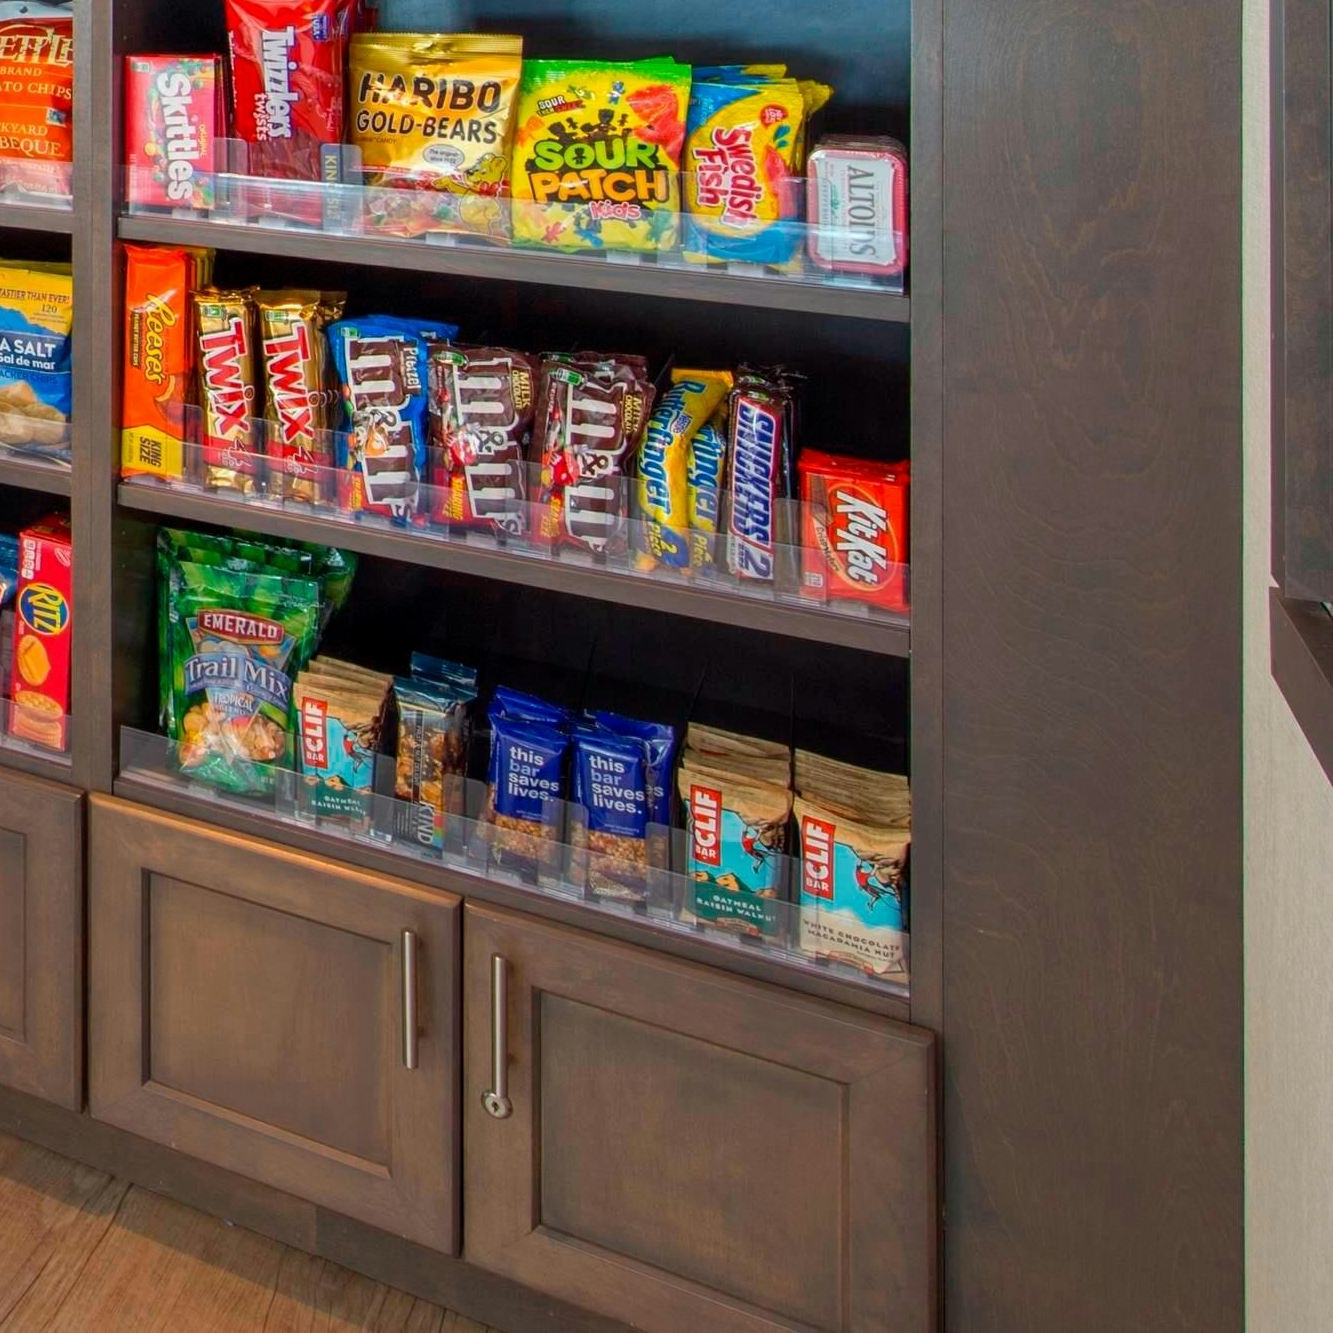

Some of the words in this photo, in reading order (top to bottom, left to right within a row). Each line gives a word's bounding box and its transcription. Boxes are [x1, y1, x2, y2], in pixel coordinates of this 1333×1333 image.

[0, 66, 43, 78] BRAND
[262, 25, 299, 139] Twizzlers
[27, 81, 73, 100] CHIPS
[358, 72, 502, 113] HARIBO
[538, 95, 566, 110] SOUR
[254, 92, 269, 142] twists
[357, 110, 497, 144] GOLD-BEARS
[157, 72, 200, 201] Skittles
[534, 136, 656, 171] SOUR
[530, 168, 669, 204] PATCH
[695, 148, 729, 206] Fish
[713, 127, 763, 228] Swedish
[589, 199, 641, 220] Kids
[847, 165, 878, 257] ALTOIDS
[26, 291, 48, 302] THAN
[48, 294, 71, 305] EVER!
[41, 303, 58, 314] 120
[10, 337, 57, 359] SALT
[145, 294, 177, 385] Reese's
[16, 354, 30, 368] de
[32, 359, 56, 371] mar
[403, 346, 421, 390] Pretzel
[518, 371, 532, 408] MILK
[140, 436, 151, 466] SIZE
[151, 439, 163, 468] KING
[640, 379, 708, 517] Butterfinger
[733, 401, 776, 547] SNICKERS
[745, 550, 771, 578] 2
[27, 583, 63, 635] RITZ
[204, 613, 278, 639] EMERALD
[187, 657, 237, 683] Trail
[244, 660, 289, 703] Mix
[214, 692, 253, 712] TROPICAL
[305, 700, 324, 753] CLIF
[306, 752, 325, 762] BAR
[509, 746, 545, 767] this
[509, 759, 540, 778] bar
[589, 754, 626, 774] this
[508, 772, 560, 792] saves
[590, 768, 623, 786] bar
[508, 782, 555, 803] lives.
[591, 782, 646, 802] saves
[593, 792, 643, 815] lives.
[694, 790, 718, 849] CLIF
[695, 846, 717, 860] BAR
[805, 821, 831, 880] CLIF
[805, 878, 830, 893] BAR
[696, 897, 733, 913] RAISIN
[712, 894, 762, 912] OATMEAL
[803, 919, 835, 936] WHITE
[837, 930, 902, 953] CHOCOLATE
[807, 928, 871, 954] MACADAMIA
[874, 947, 896, 959] NUT
